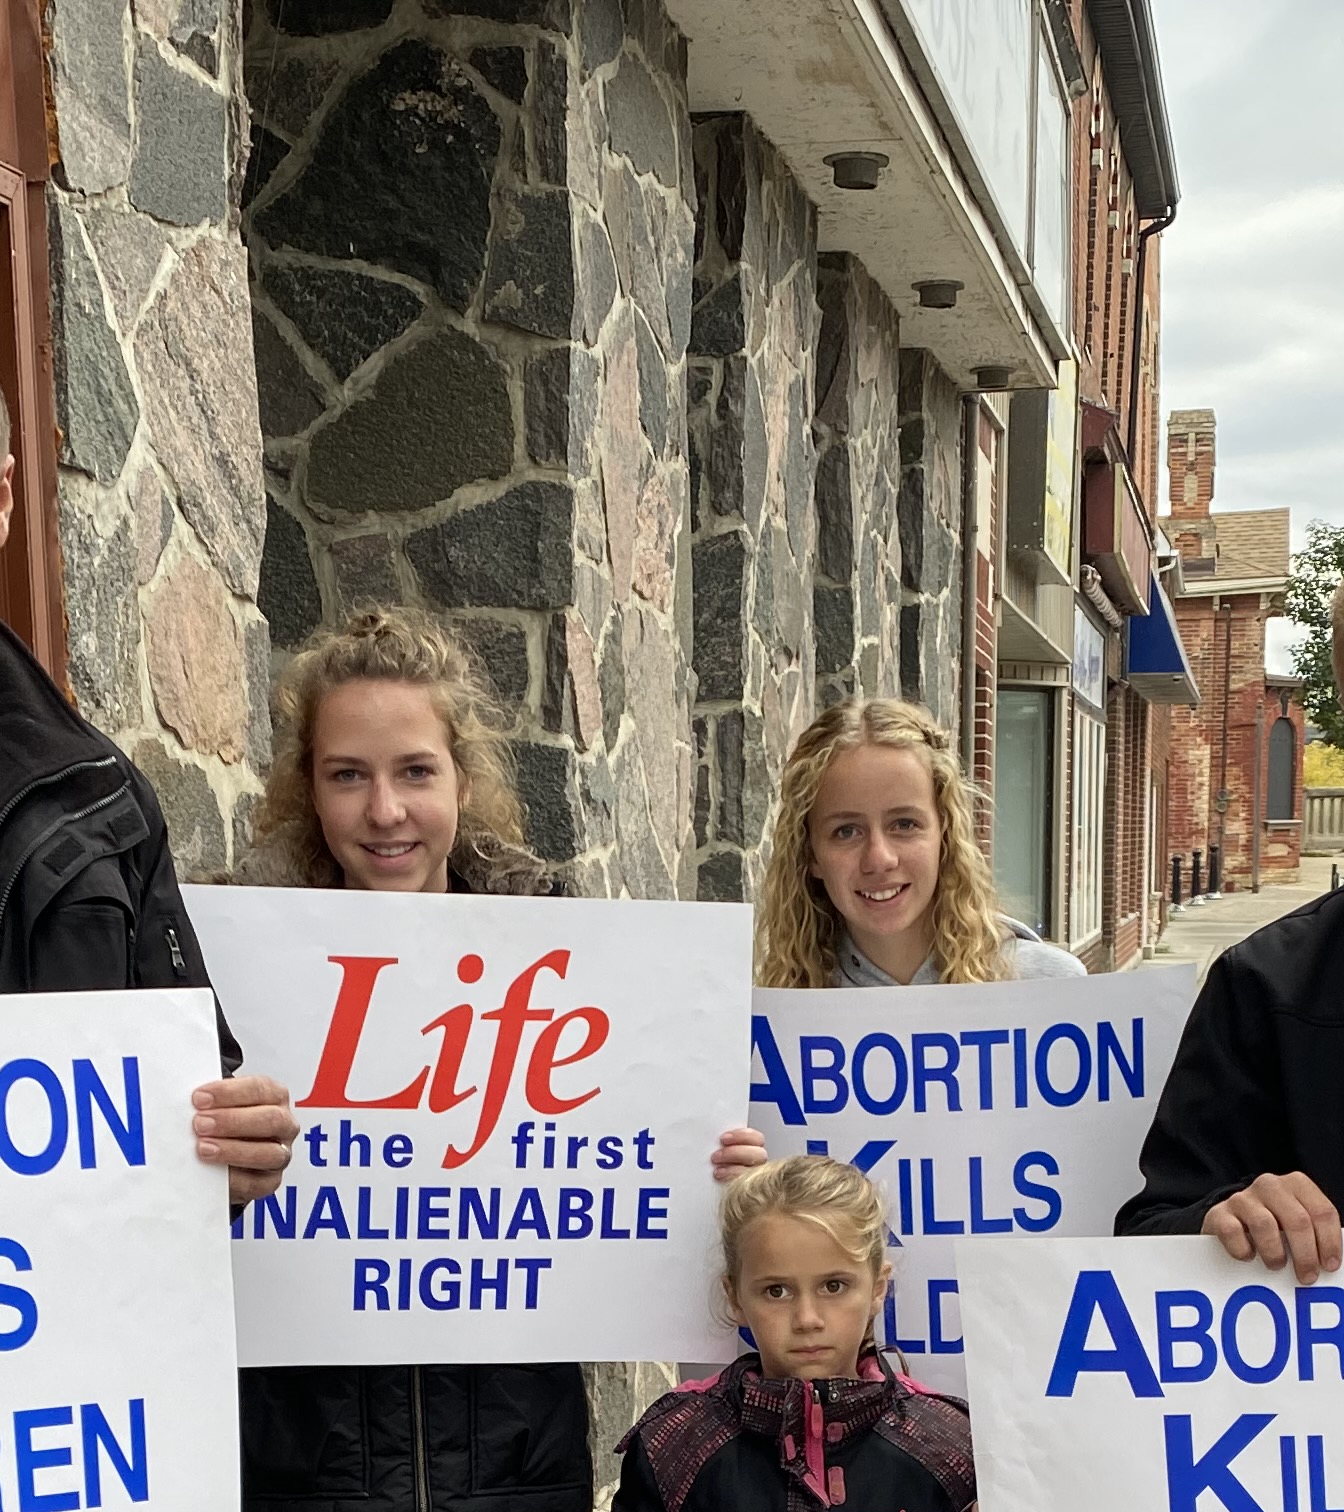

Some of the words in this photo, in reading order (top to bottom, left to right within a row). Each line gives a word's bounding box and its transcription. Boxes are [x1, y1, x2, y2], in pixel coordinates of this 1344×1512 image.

[295, 949, 610, 1169] Life
[750, 1016, 1145, 1126] ABORTION
[305, 1119, 414, 1168] the
[511, 1121, 655, 1170] first
[807, 1139, 1062, 1248] ILLS
[353, 1257, 552, 1311] RIGHT
